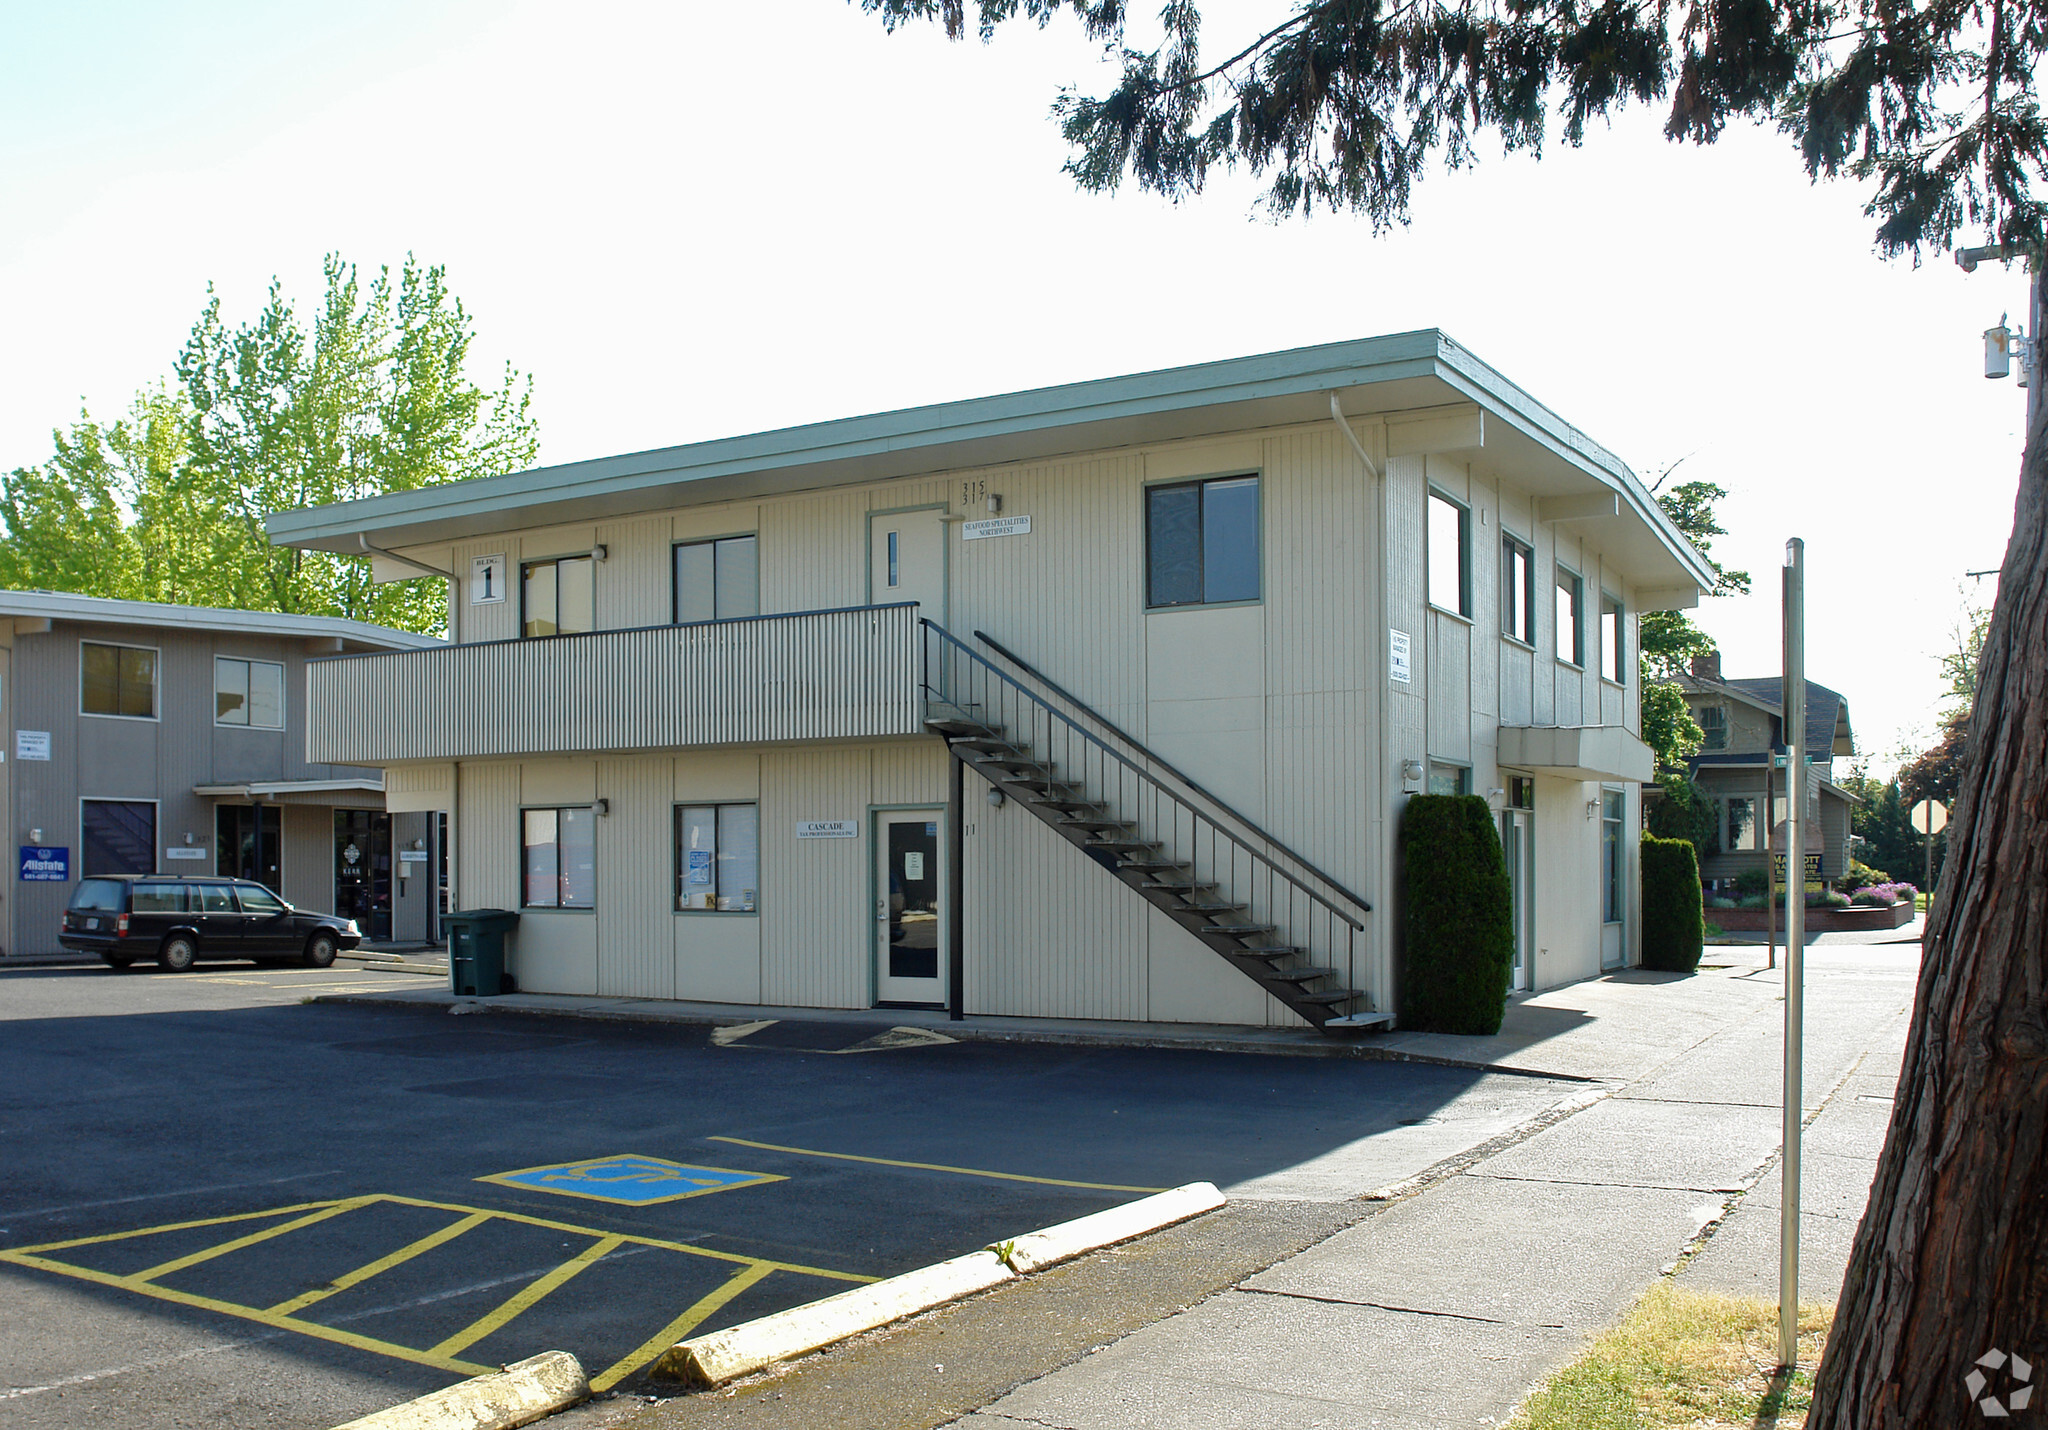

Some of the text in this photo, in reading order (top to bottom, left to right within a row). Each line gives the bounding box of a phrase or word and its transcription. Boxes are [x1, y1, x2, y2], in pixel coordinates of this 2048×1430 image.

[962, 480, 984, 493] 315
[962, 491, 984, 505] 317
[965, 519, 990, 530] SEAFOOD
[979, 526, 1014, 536] NORTHWEST
[480, 565, 496, 599] 1
[808, 822, 844, 831] CASCADE
[22, 860, 66, 871] Allstate
